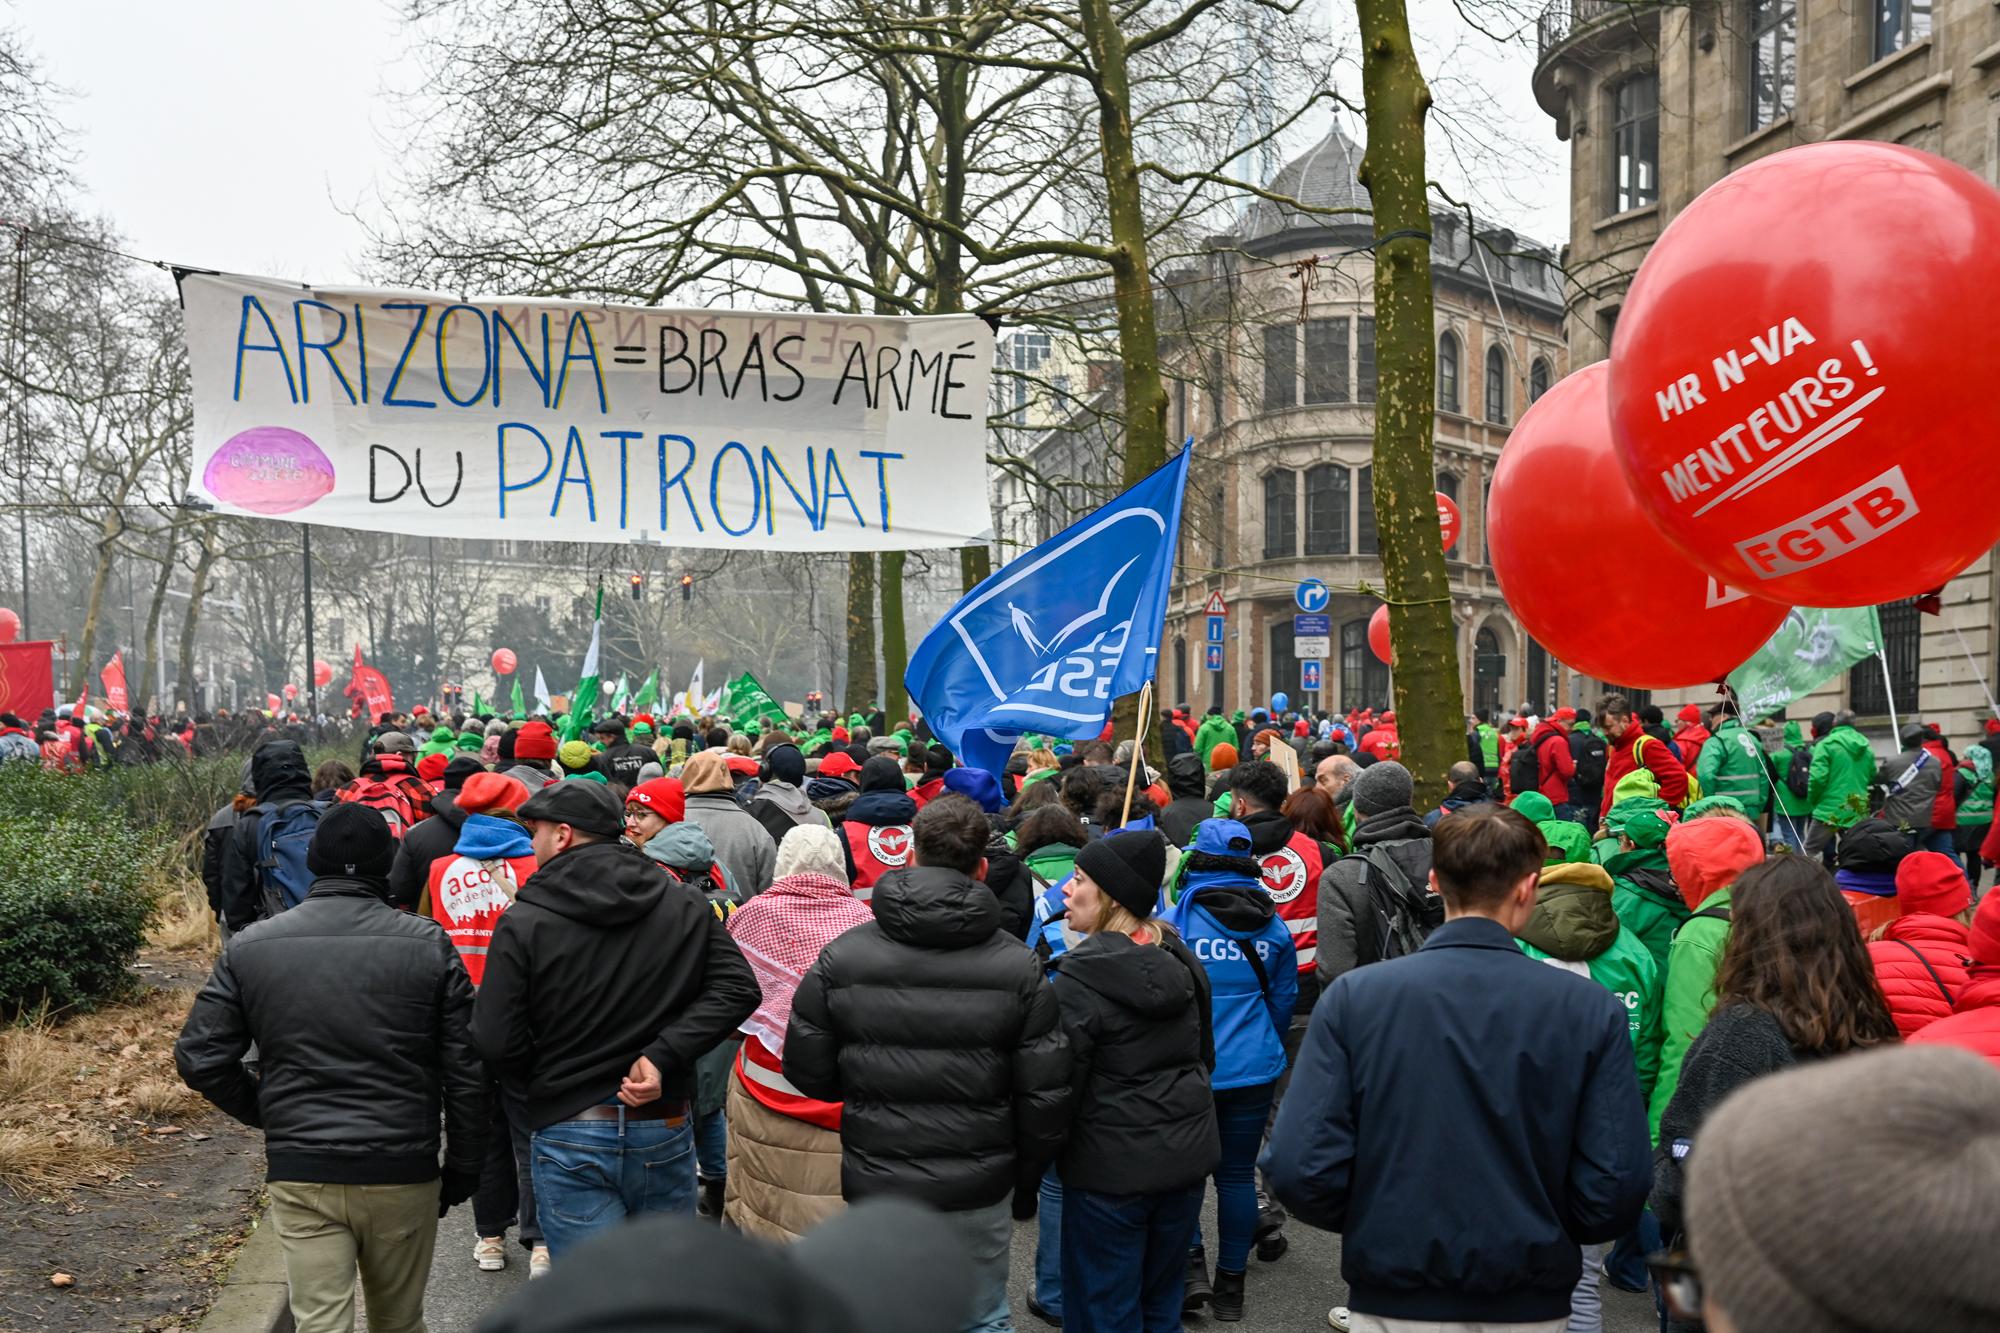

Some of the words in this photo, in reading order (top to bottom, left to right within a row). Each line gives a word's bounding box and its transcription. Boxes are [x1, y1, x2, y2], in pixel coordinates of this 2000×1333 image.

[233, 295, 607, 414] ARIZONA
[660, 325, 805, 401] BRAS
[833, 340, 976, 419] ARMÉ
[1655, 373, 1707, 422] MR
[1712, 317, 1816, 392] N-VA
[370, 444, 462, 507] DU
[497, 422, 905, 536] PATRONAT
[1661, 358, 1855, 503] MENTEURS
[1743, 486, 1907, 575] FGTB
[1272, 874, 1304, 900] CHEMINOTS
